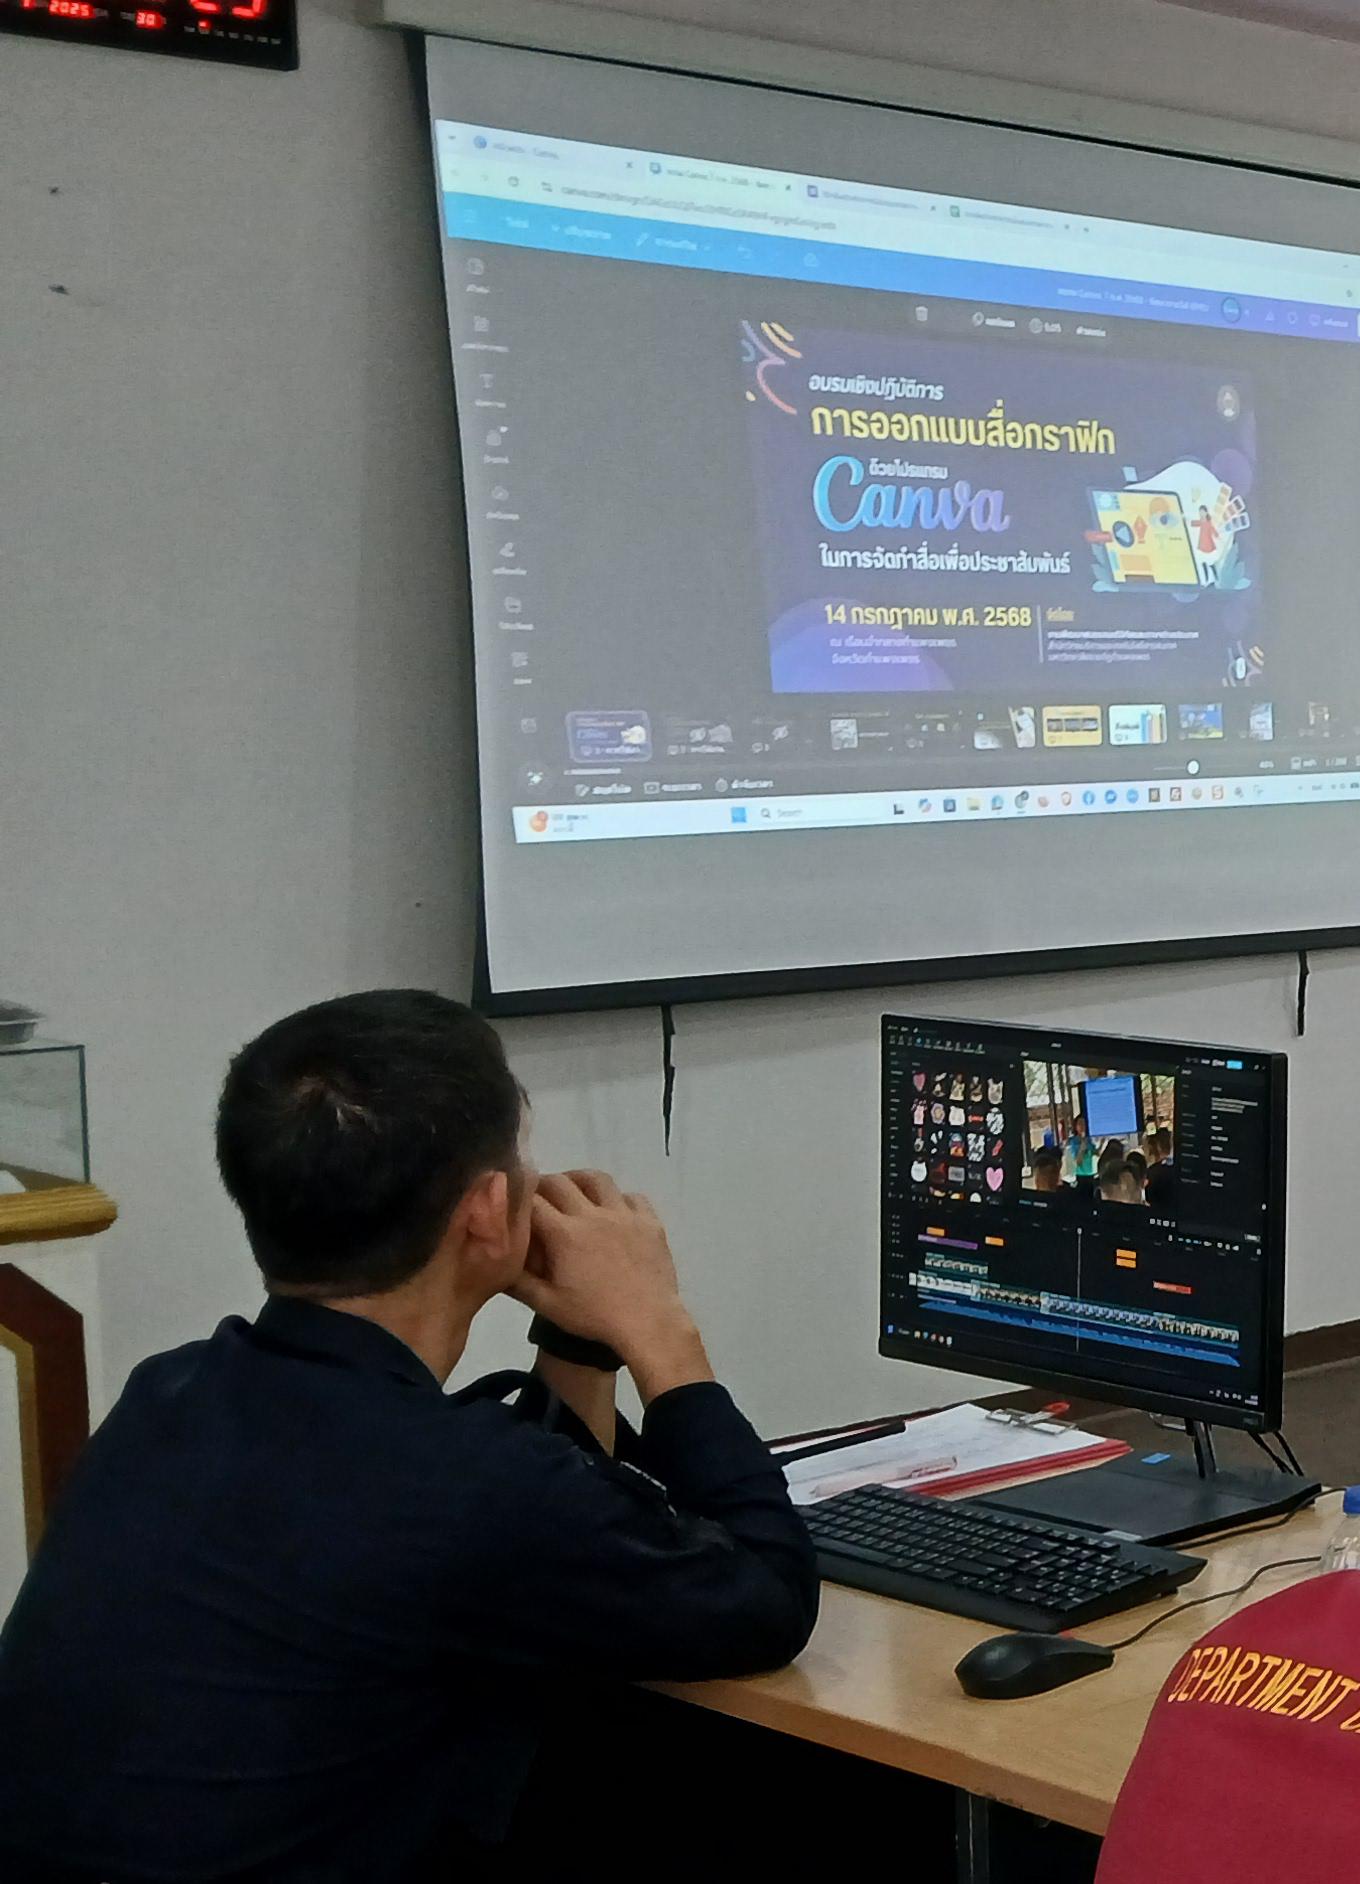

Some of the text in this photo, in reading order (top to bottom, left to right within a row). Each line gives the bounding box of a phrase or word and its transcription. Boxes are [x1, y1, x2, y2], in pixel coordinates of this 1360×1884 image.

[808, 373, 945, 401] อบรมเชิงปฏิบัติการ
[810, 400, 1117, 455] การออกแบบสื่อกราฟิก
[812, 455, 1011, 533] Canva
[818, 541, 1072, 574] ในการจัดทำสื่อเพื่อประชาสัมพันธ์
[824, 603, 1033, 631] 14 กรกฎาคม พ.ศ. 2568
